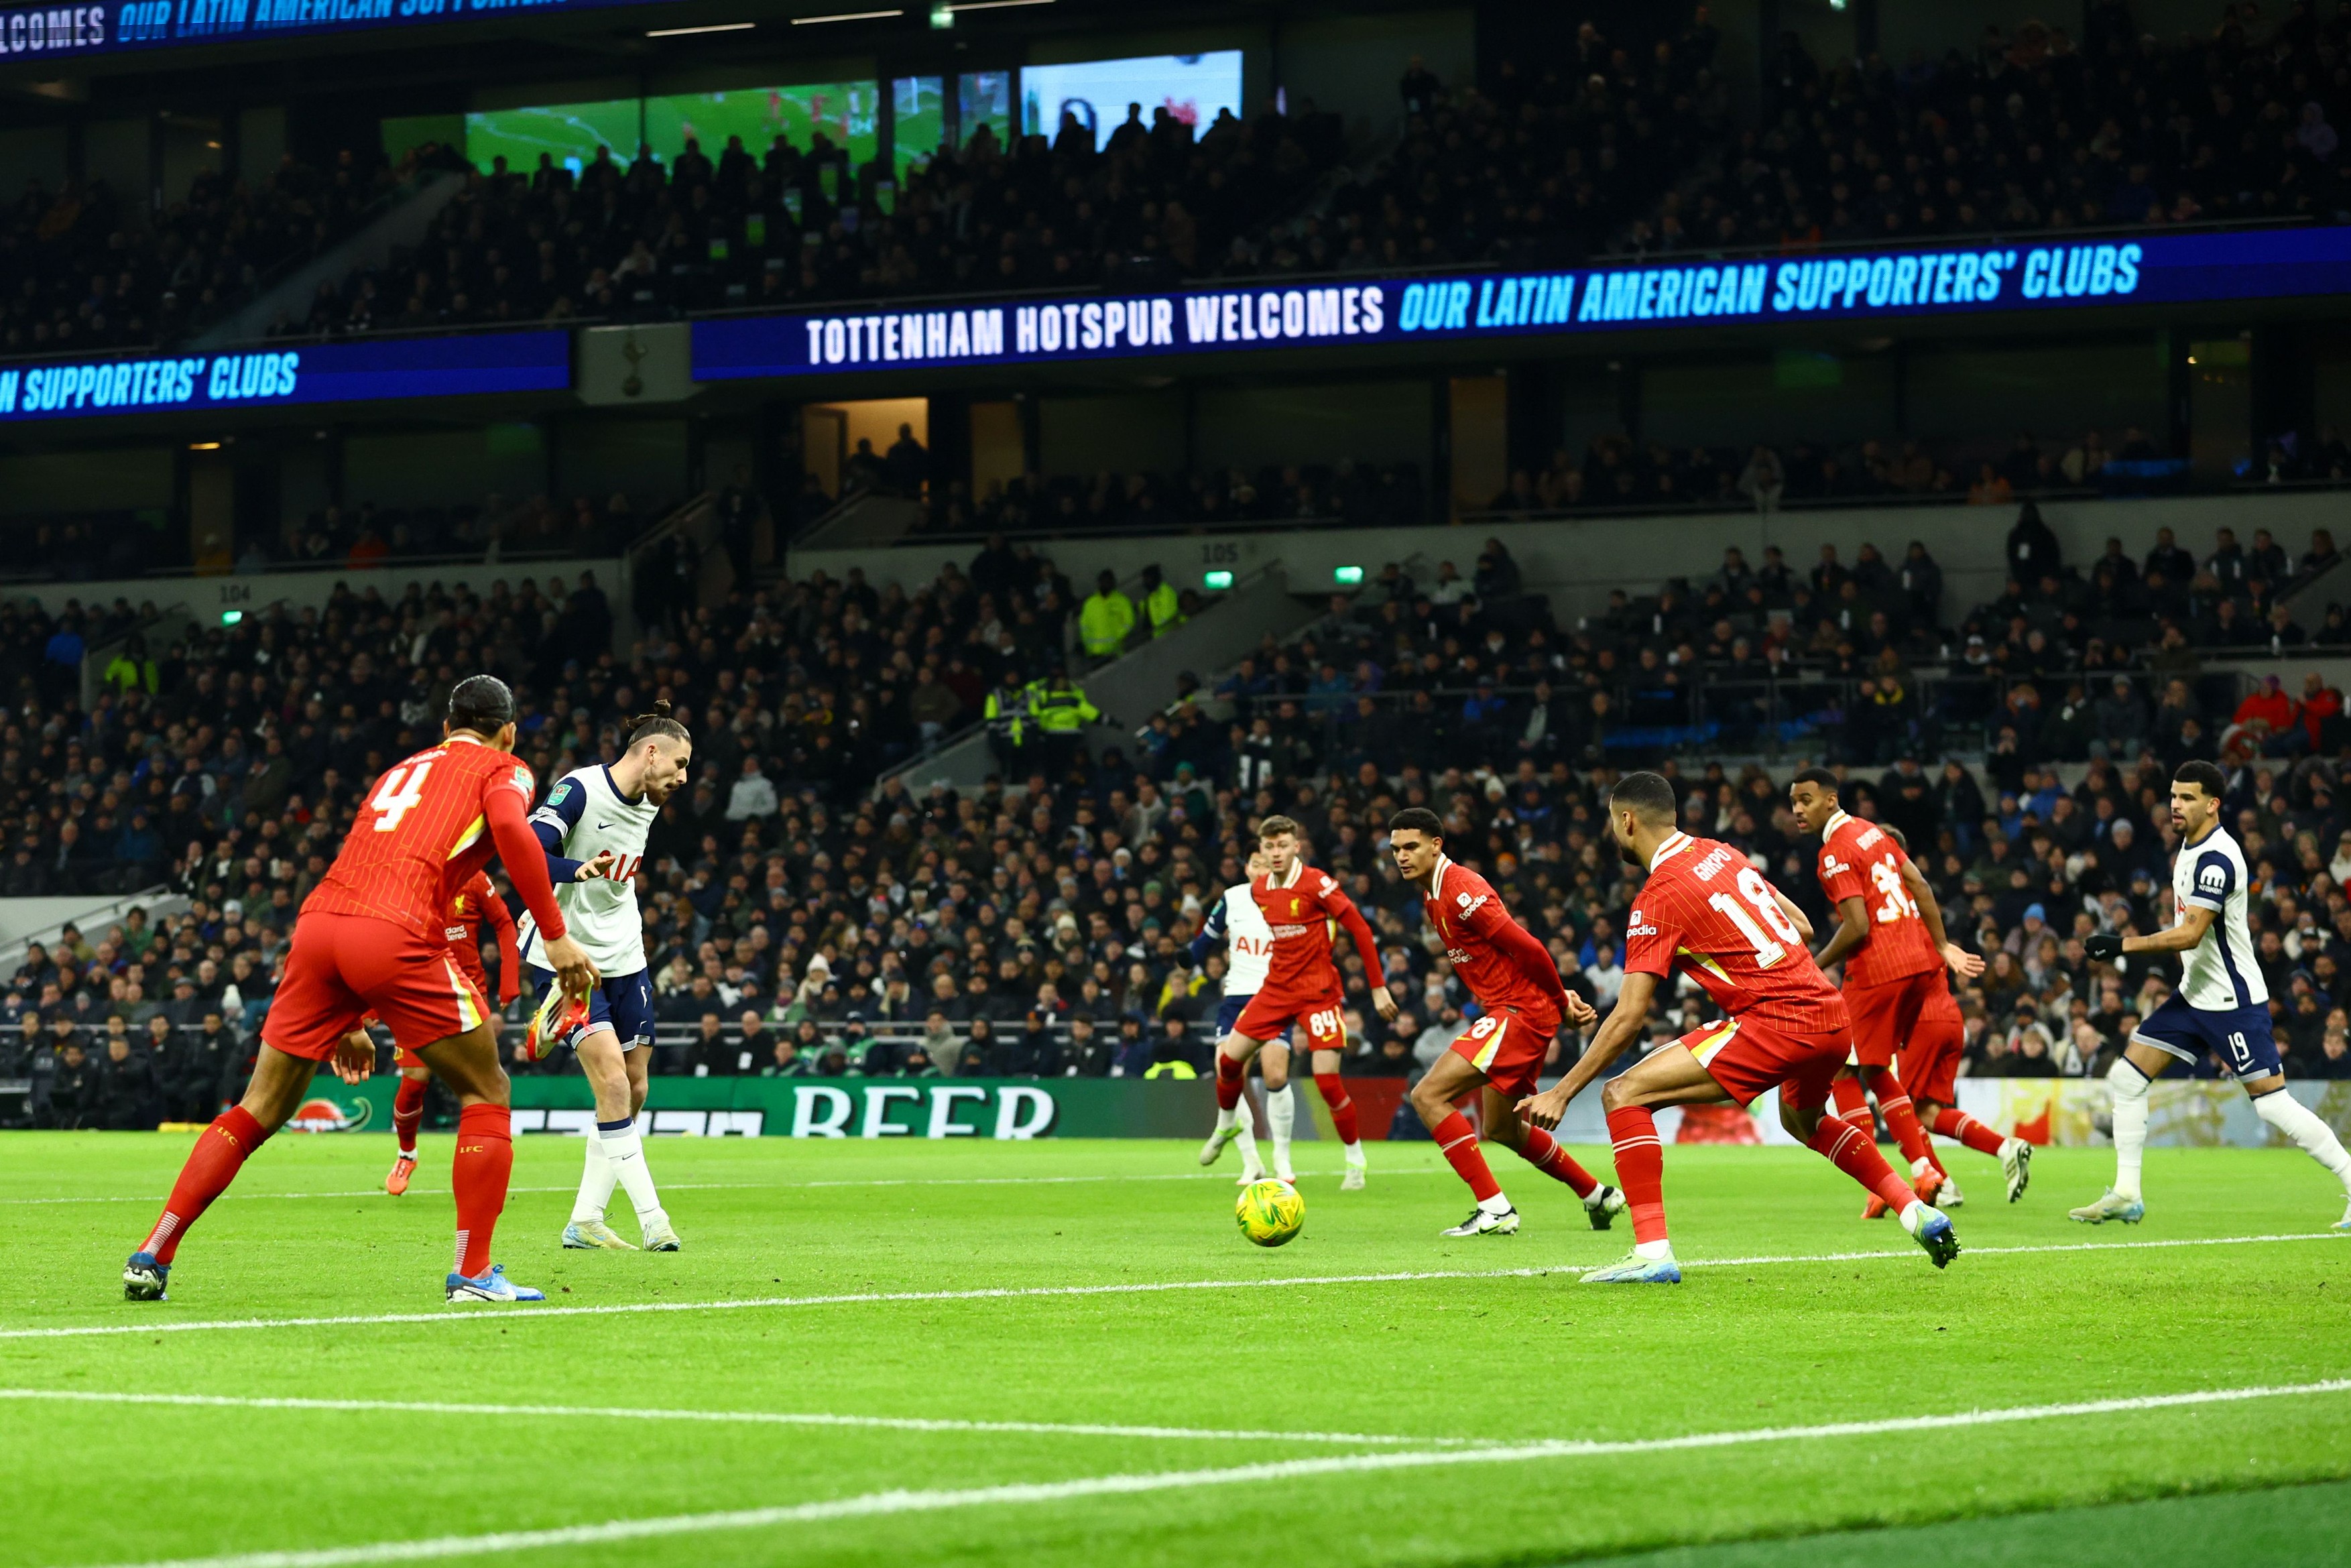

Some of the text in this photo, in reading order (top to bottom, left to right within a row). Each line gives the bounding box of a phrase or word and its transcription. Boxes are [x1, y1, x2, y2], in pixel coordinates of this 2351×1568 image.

[117, 1, 172, 42] OUR
[176, 0, 249, 38] LATIN
[806, 243, 2142, 365] TOTTENHAM HOTSPUR WELCOMES OUR LATIN AMERICAN SUPPORTERS' CLUBS
[22, 358, 206, 411] SUPPORTERS'
[208, 352, 299, 400] CLUBS
[1203, 542, 1238, 563] 105
[221, 584, 250, 603] 104
[371, 762, 433, 832] 4
[1693, 847, 1732, 882] GAKPO
[1707, 865, 1801, 969] 18
[1309, 1010, 1338, 1037] 84
[1471, 1016, 1497, 1039] 8
[2228, 1031, 2250, 1063] 19
[217, 1126, 238, 1146] LFC
[460, 1145, 483, 1153] LFC
[1851, 1138, 1869, 1156] LFC
